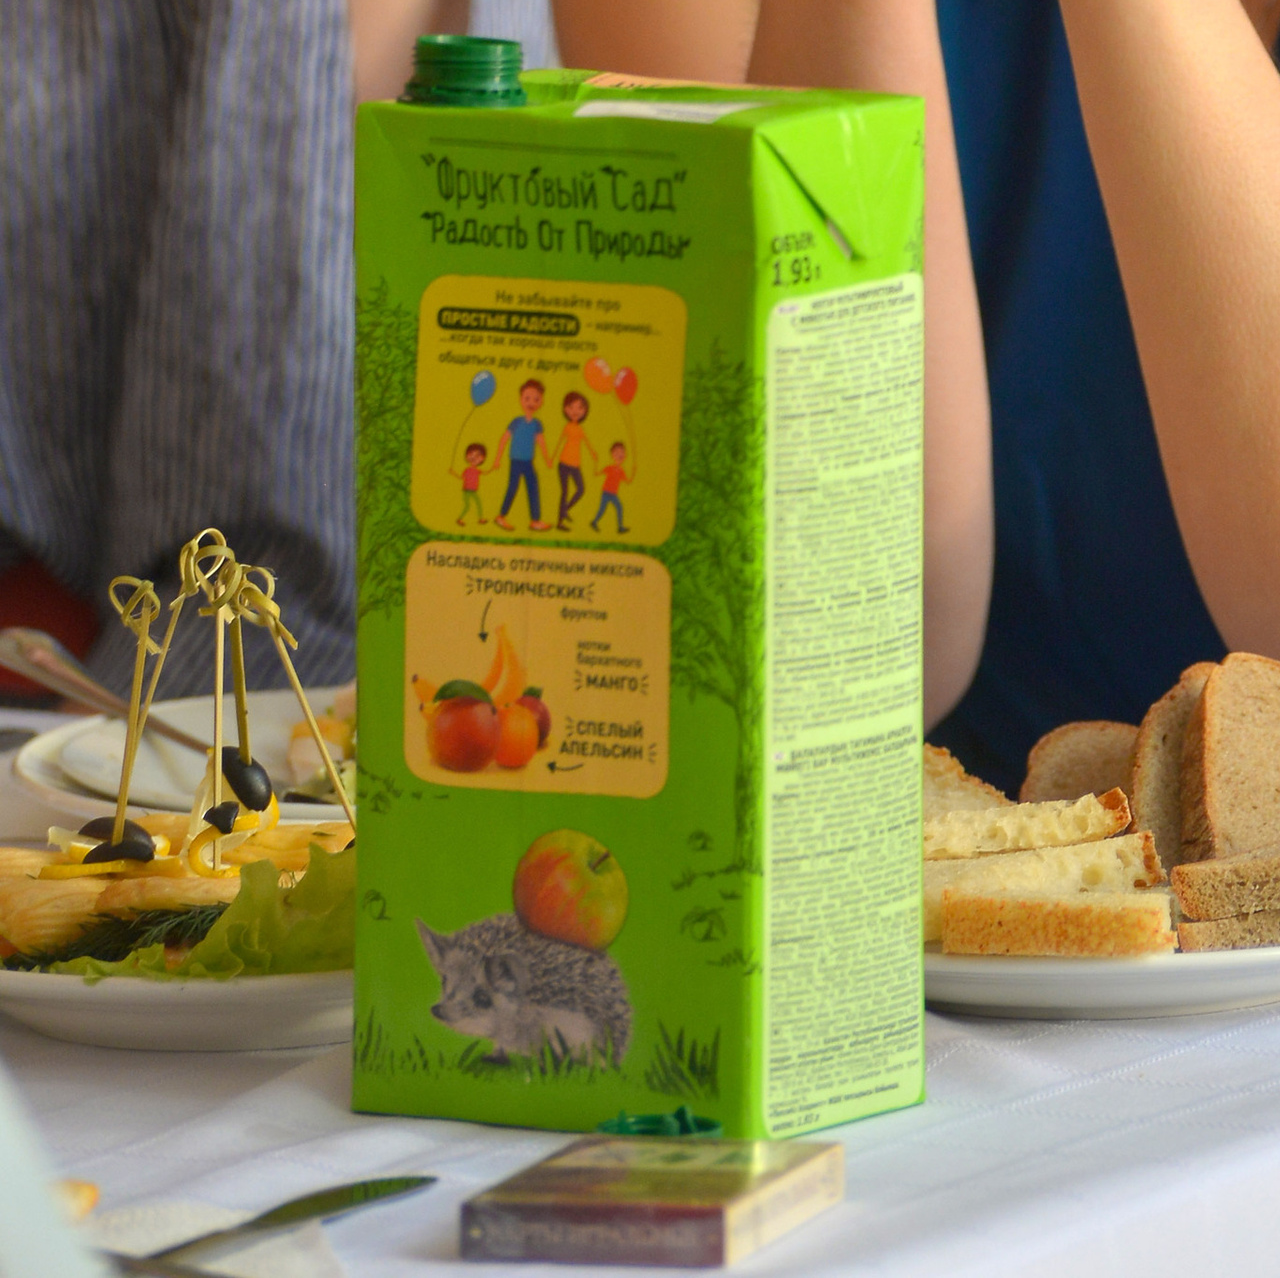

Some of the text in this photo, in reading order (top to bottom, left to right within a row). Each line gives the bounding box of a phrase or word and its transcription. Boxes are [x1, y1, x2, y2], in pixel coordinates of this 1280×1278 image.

[537, 218, 565, 253] От
[495, 289, 621, 312] Не забывайте про
[441, 310, 508, 329] ПРОСТЫЕ
[510, 314, 578, 334] РАДОСТИ
[486, 335, 505, 347] так
[508, 337, 555, 351] хорошо
[558, 340, 598, 353] просто
[438, 350, 496, 367] общаться
[498, 353, 523, 370] друг
[536, 355, 580, 372] другом
[426, 550, 645, 578] Насладись отличным миксом
[475, 577, 587, 600] ТРОПИЧЕСКИХ
[560, 605, 608, 623] фруктов
[577, 640, 611, 652] нотки
[577, 651, 643, 668] бархатного
[586, 674, 639, 692] МАНГО
[576, 719, 644, 740] СПЕЛЫЙ
[559, 740, 644, 760] АПЕЛЬСИН
